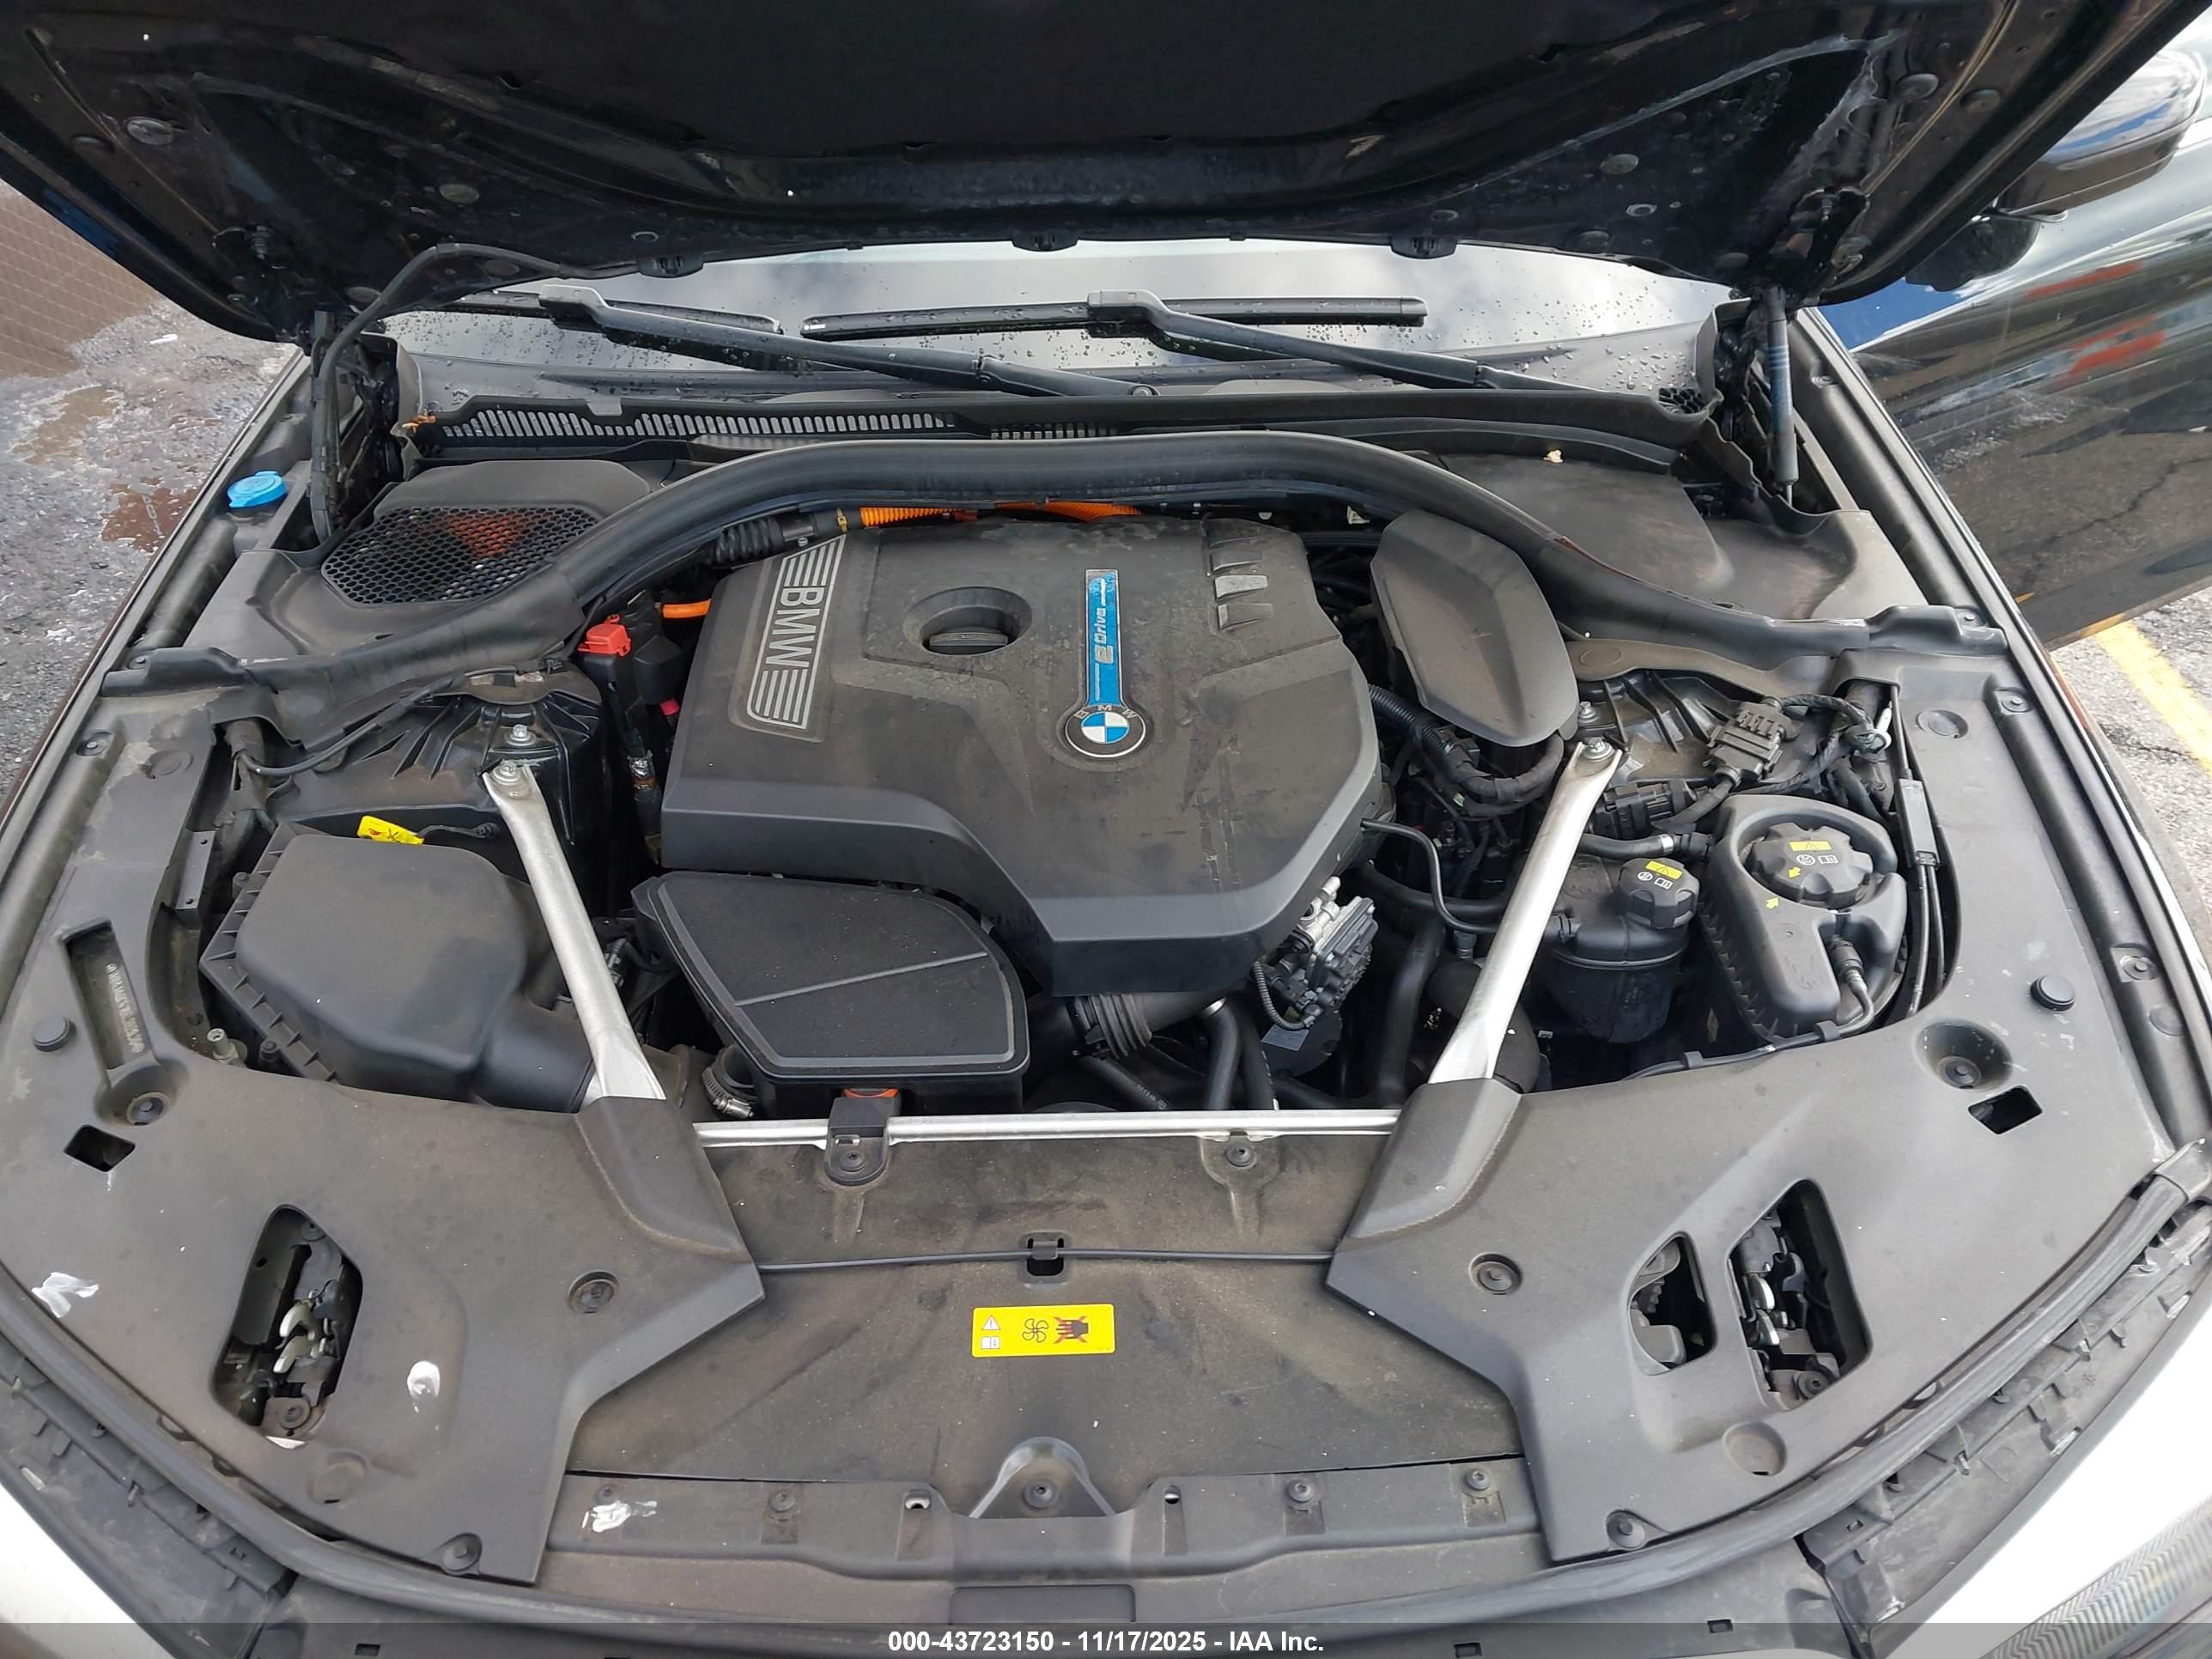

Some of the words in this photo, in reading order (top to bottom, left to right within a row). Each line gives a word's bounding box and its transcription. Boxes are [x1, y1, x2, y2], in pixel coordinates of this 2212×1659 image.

[766, 587, 825, 668] BMW
[1094, 607, 1114, 664] eDrive
[1074, 704, 1137, 720] BMW
